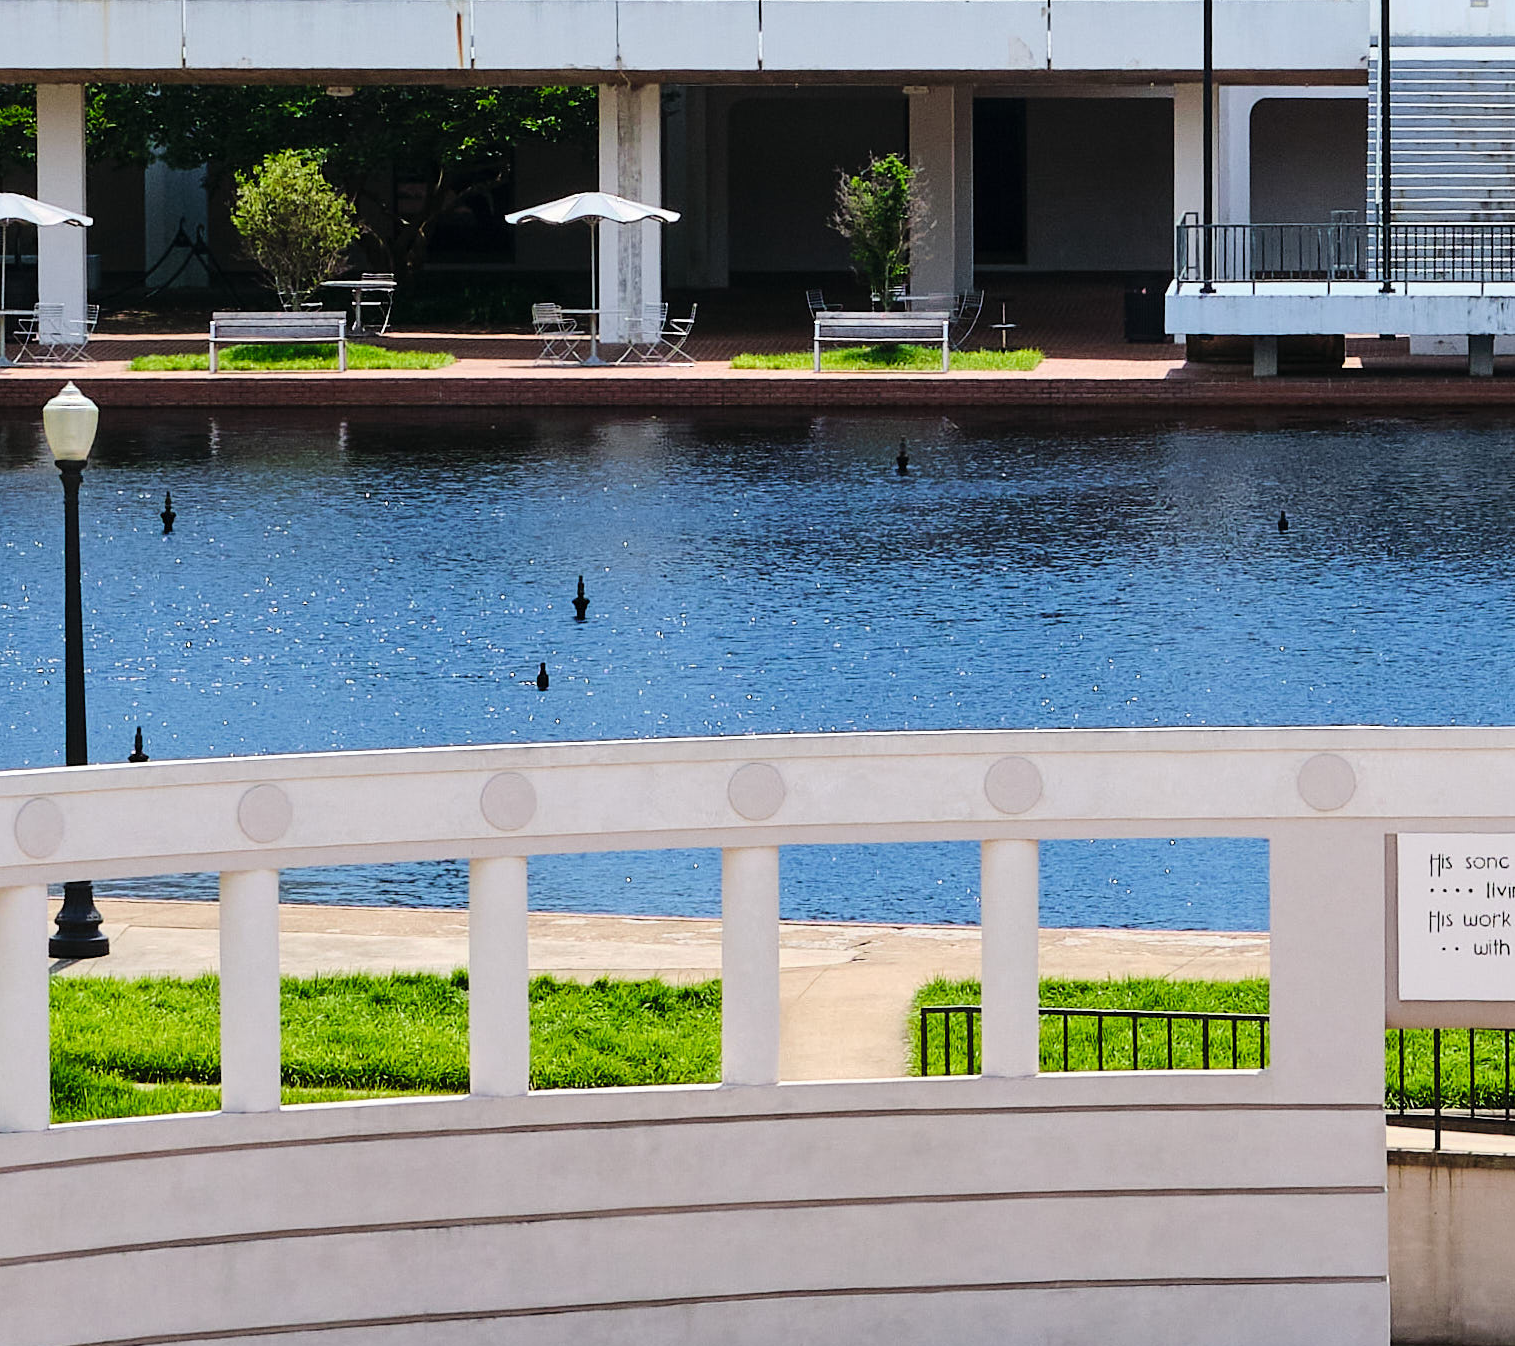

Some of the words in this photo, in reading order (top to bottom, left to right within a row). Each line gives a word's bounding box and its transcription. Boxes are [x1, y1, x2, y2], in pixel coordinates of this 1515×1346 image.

[1429, 853, 1453, 878] His
[1428, 910, 1454, 934] His
[1462, 910, 1512, 929] work
[1472, 938, 1511, 957] with
